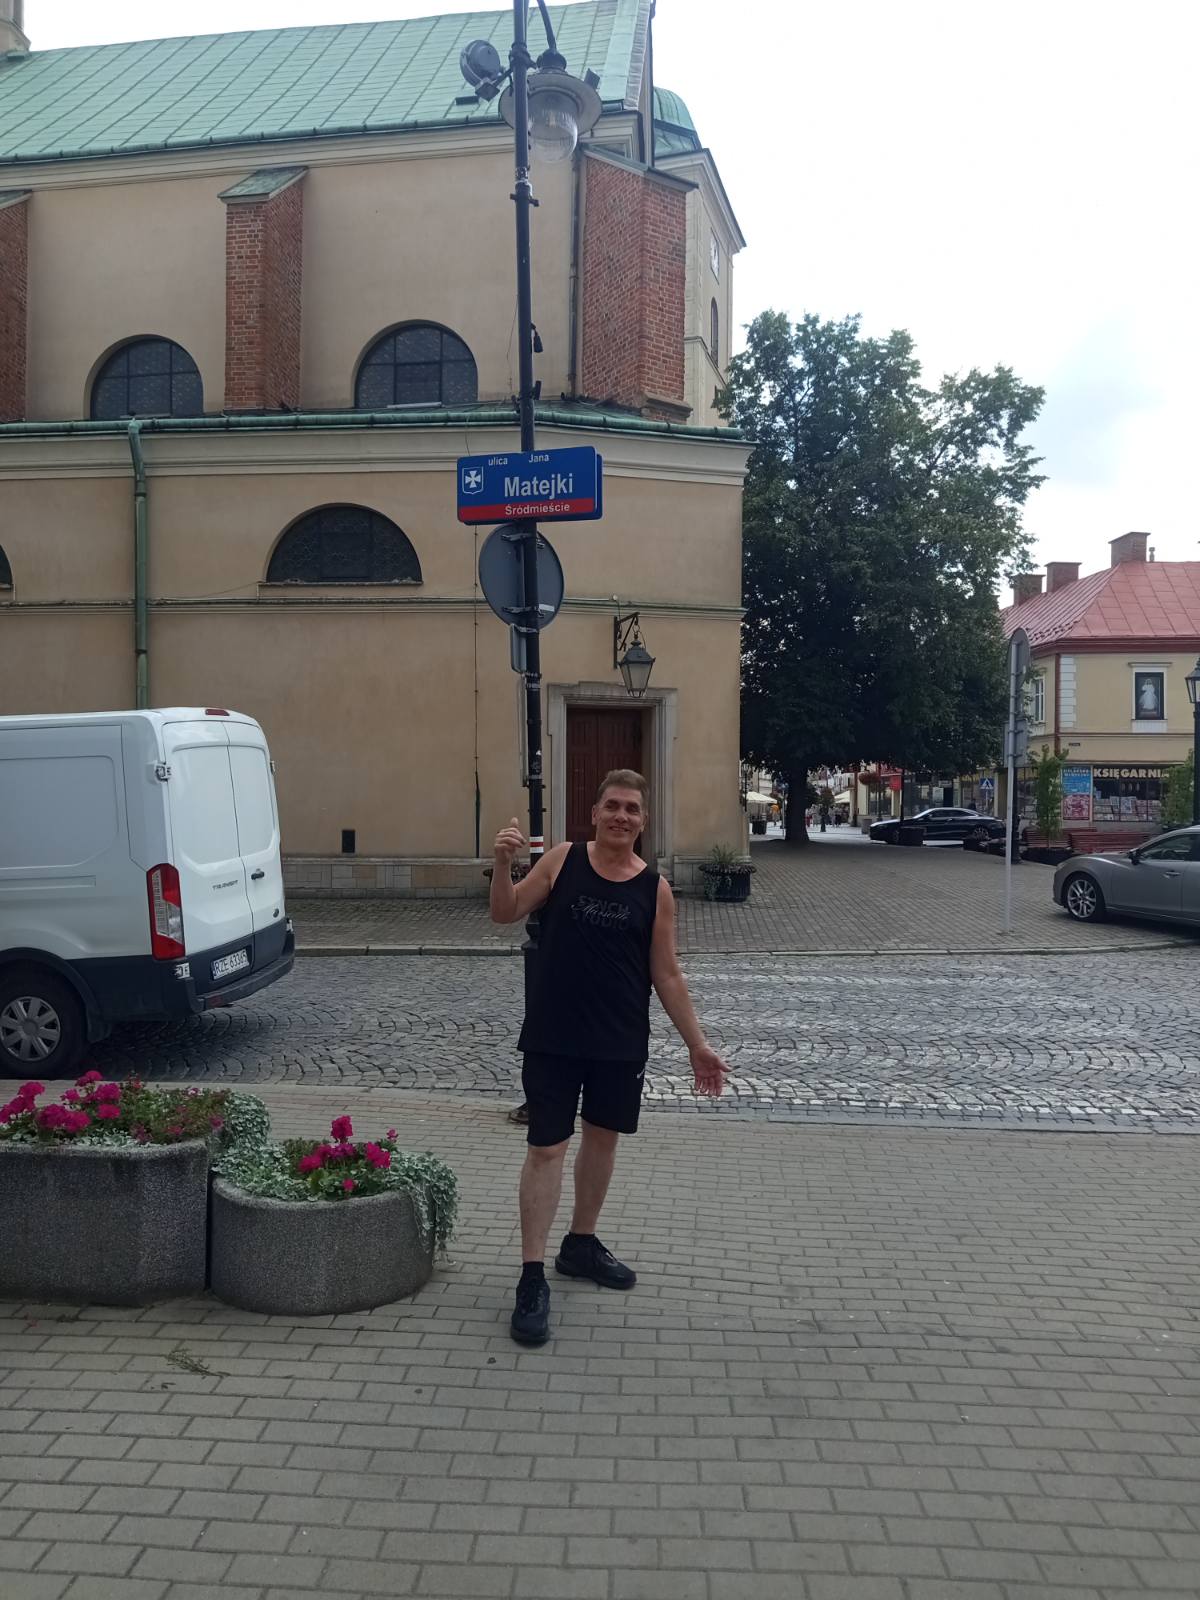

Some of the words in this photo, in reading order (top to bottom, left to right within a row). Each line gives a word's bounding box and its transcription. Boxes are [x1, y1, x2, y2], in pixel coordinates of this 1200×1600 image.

[488, 457, 508, 466] ulica
[528, 454, 550, 463] Jana
[504, 473, 573, 499] Matejki
[505, 502, 570, 516] Śródmieście
